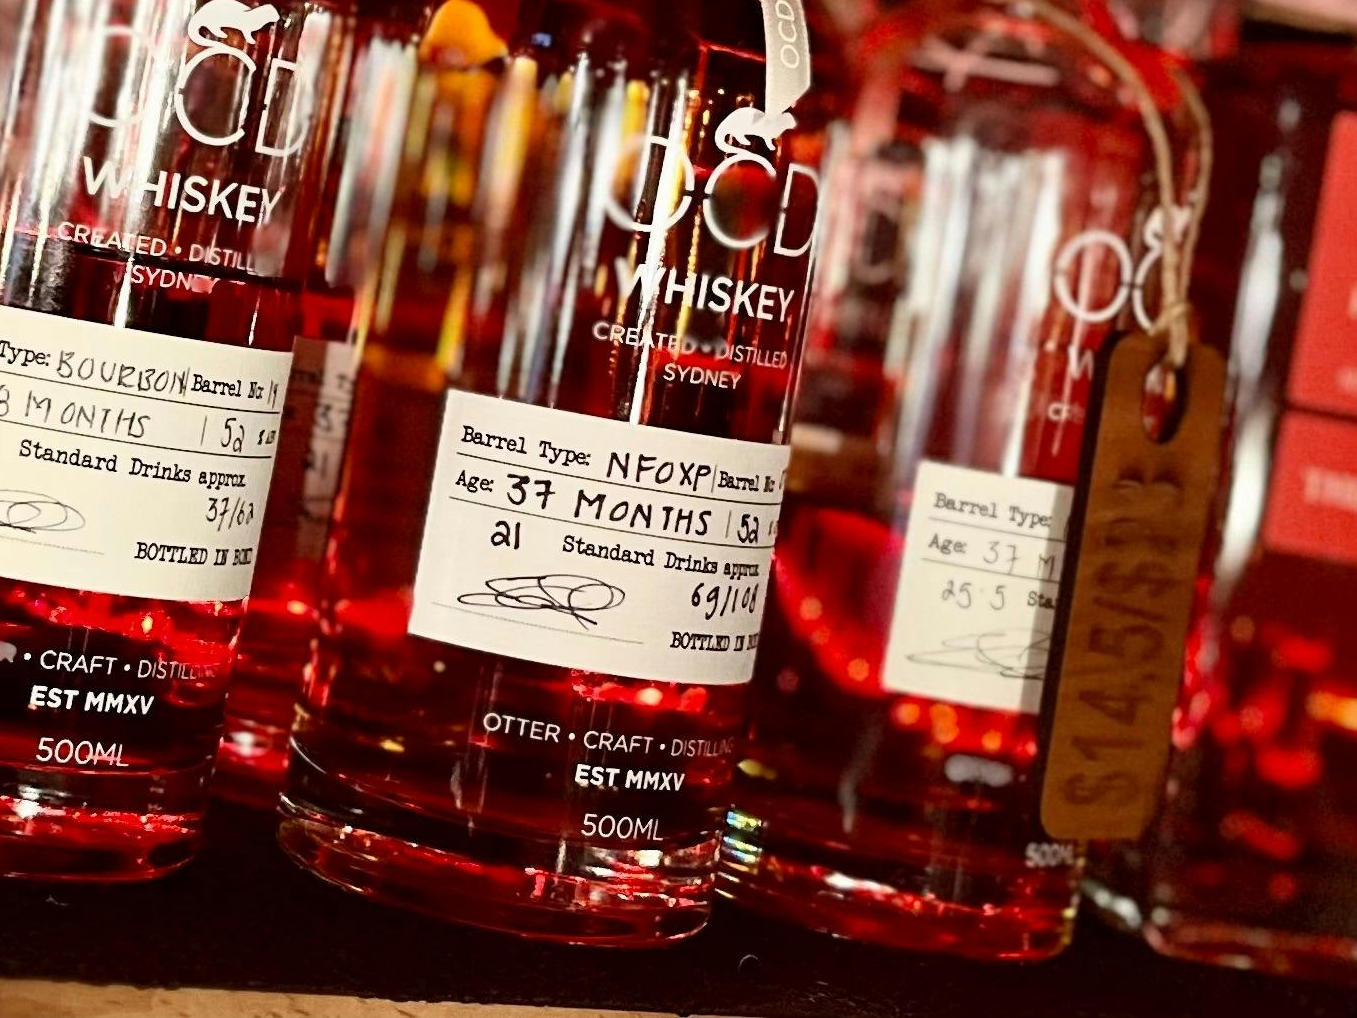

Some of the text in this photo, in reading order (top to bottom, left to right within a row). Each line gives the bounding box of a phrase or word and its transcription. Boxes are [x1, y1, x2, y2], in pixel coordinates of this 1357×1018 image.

[775, 0, 800, 68] OCD
[83, 25, 313, 157] OCD
[83, 156, 286, 230] WHISKEY
[606, 135, 820, 257] OCD
[57, 221, 258, 273] CREATED DISTILL
[614, 256, 795, 323] WHISKEY
[593, 321, 787, 370] CREATED DISTILLED
[57, 350, 187, 397] BOURBON
[191, 374, 241, 397] Barrel
[662, 362, 742, 390] SYDNEY
[26, 389, 150, 438] MONTHS
[19, 439, 118, 473] Standard
[129, 458, 191, 484] Drinks
[460, 425, 527, 455] Barrel
[539, 440, 591, 467] Type:
[606, 451, 712, 492] NFOXP
[718, 470, 760, 492] Barrel
[455, 470, 493, 494] Age:
[505, 473, 556, 510] 37
[574, 490, 712, 536] MONTHS
[934, 492, 1052, 528] Barrel Type:
[135, 542, 208, 566] BOTTLED
[490, 520, 521, 550] 21
[562, 535, 655, 567] Standard
[664, 551, 718, 575] Drinks
[928, 534, 967, 555] Age:
[983, 540, 1019, 575] 37
[40, 650, 118, 675] CRAFT
[670, 631, 730, 651] BOTTLED
[29, 685, 154, 715] EST MMXV
[36, 737, 129, 767] 500ML
[483, 712, 735, 757] OTTER CRAFT DISTILLING
[575, 764, 685, 792] EST MMXV
[581, 813, 664, 842] 500ML
